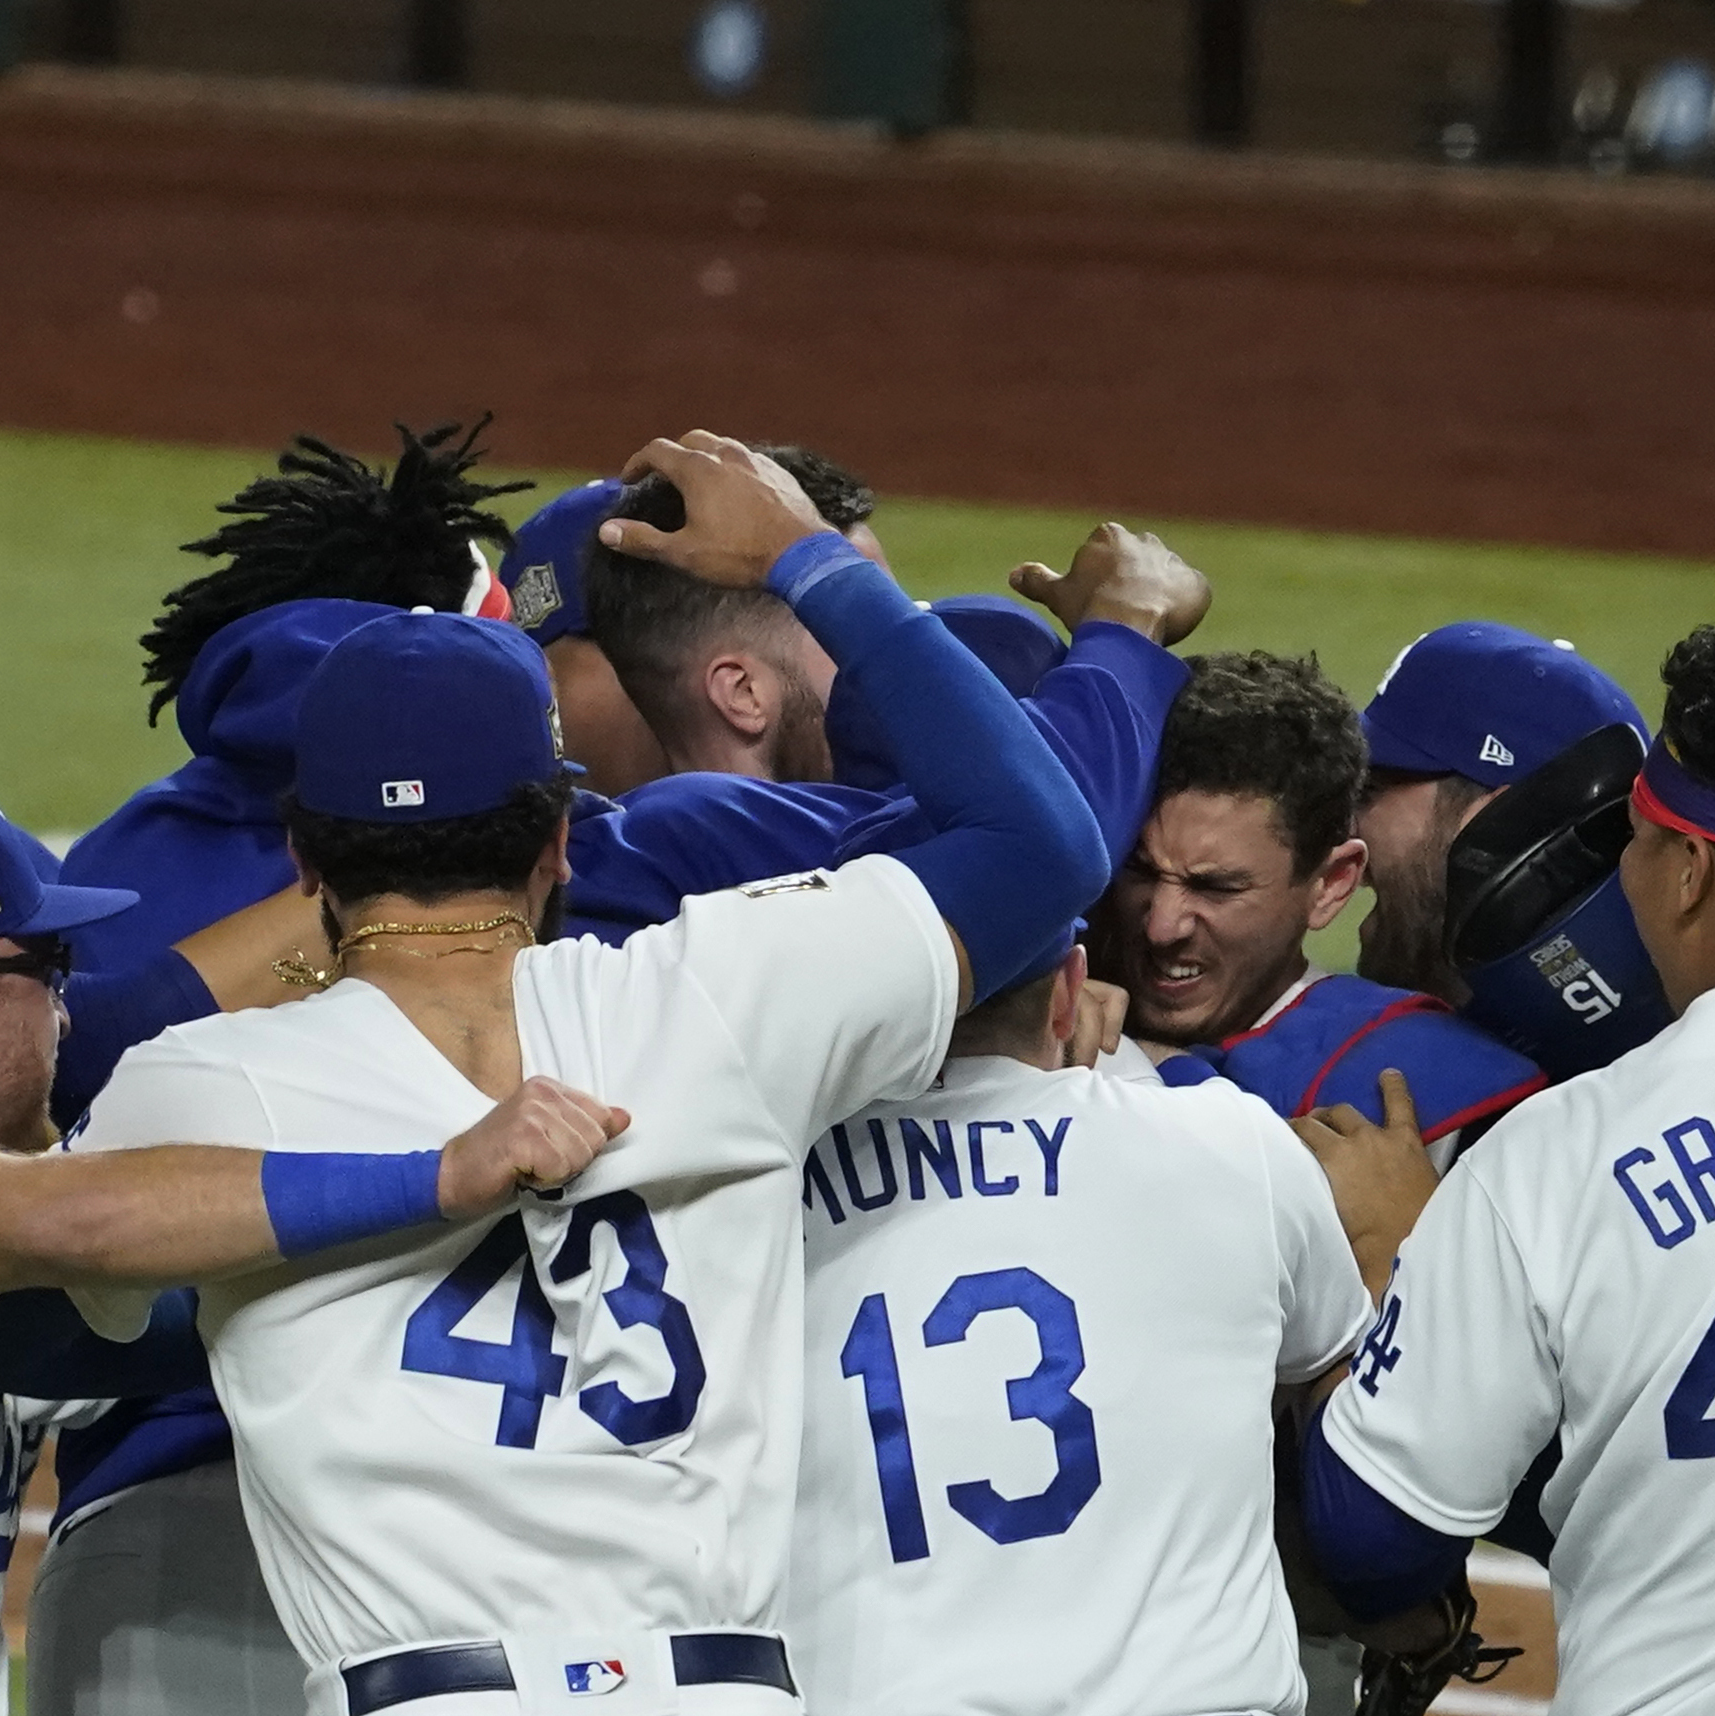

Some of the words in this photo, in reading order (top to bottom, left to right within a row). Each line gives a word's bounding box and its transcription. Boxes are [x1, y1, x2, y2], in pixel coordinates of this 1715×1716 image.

[1562, 969, 1622, 1025] 15
[400, 1188, 708, 1451] 43
[840, 1266, 1103, 1564] 13
